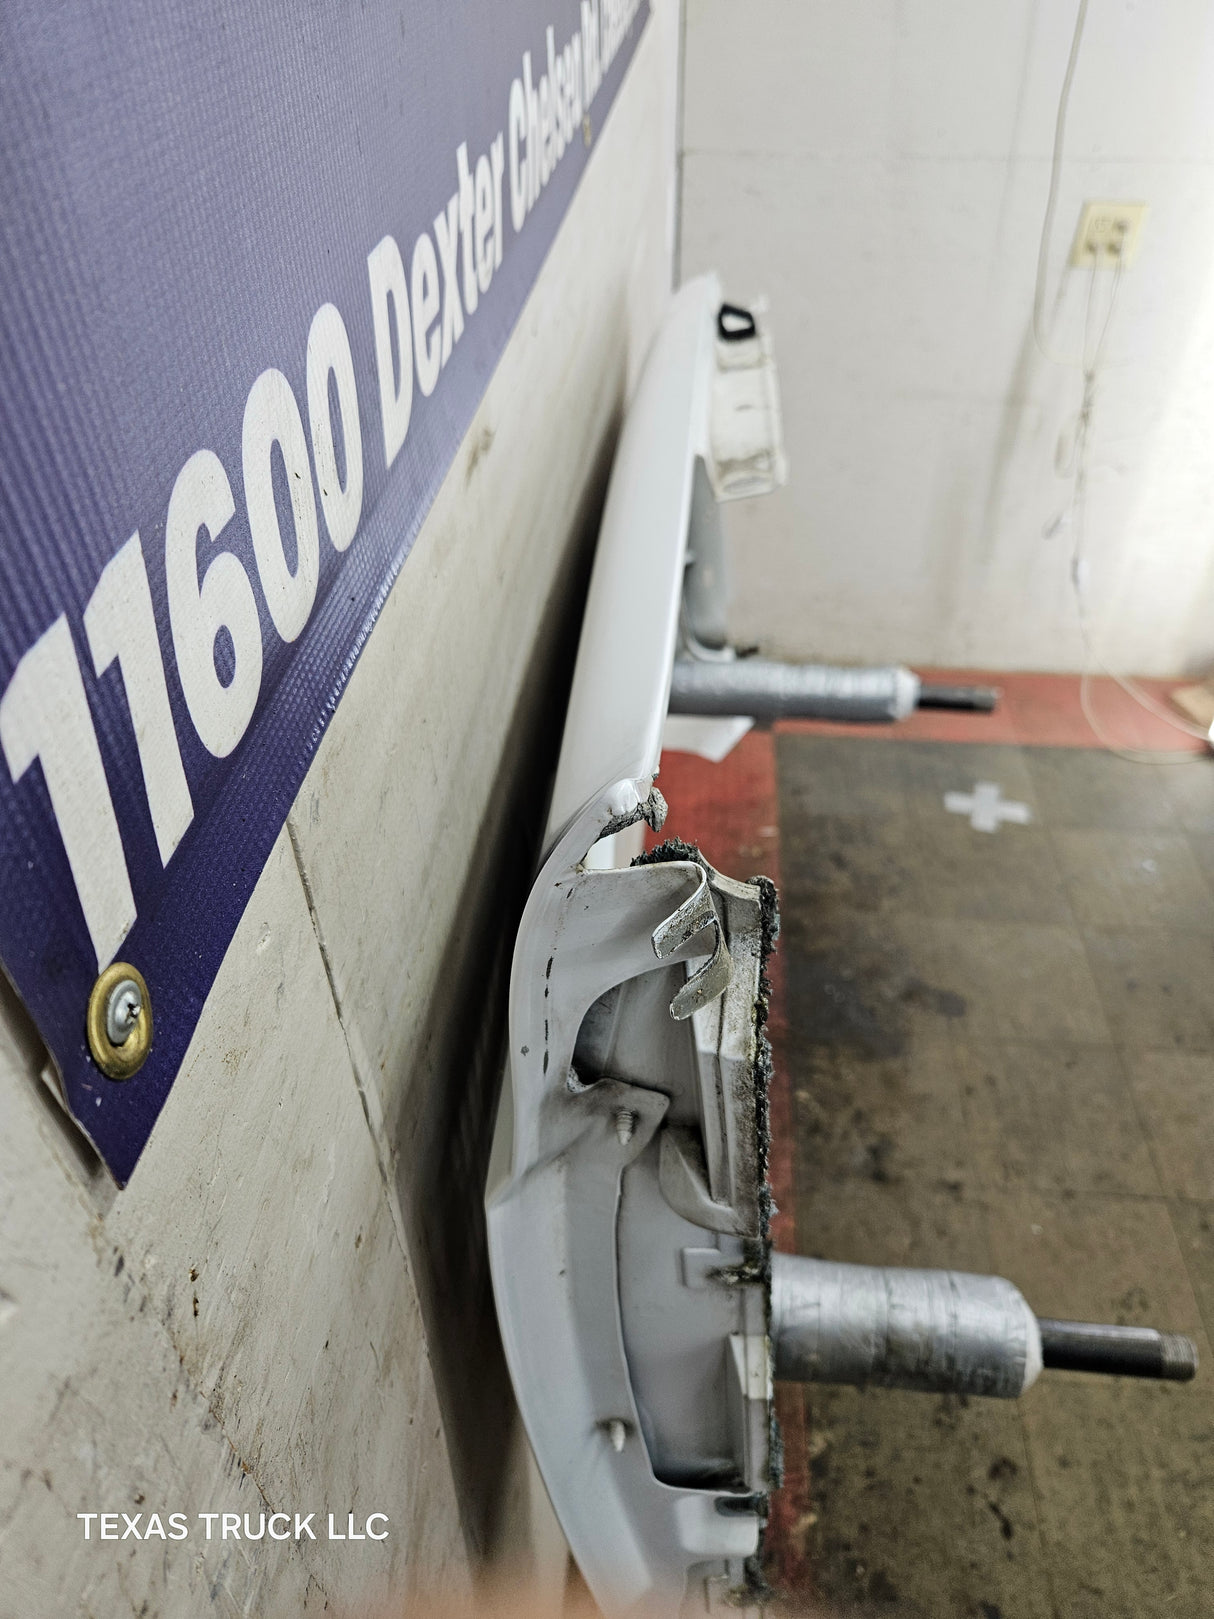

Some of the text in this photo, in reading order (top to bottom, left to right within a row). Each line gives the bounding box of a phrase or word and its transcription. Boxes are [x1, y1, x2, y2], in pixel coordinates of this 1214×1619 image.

[0, 302, 364, 974] 11600
[367, 130, 504, 469] Dexter
[509, 24, 582, 232] Chelsea
